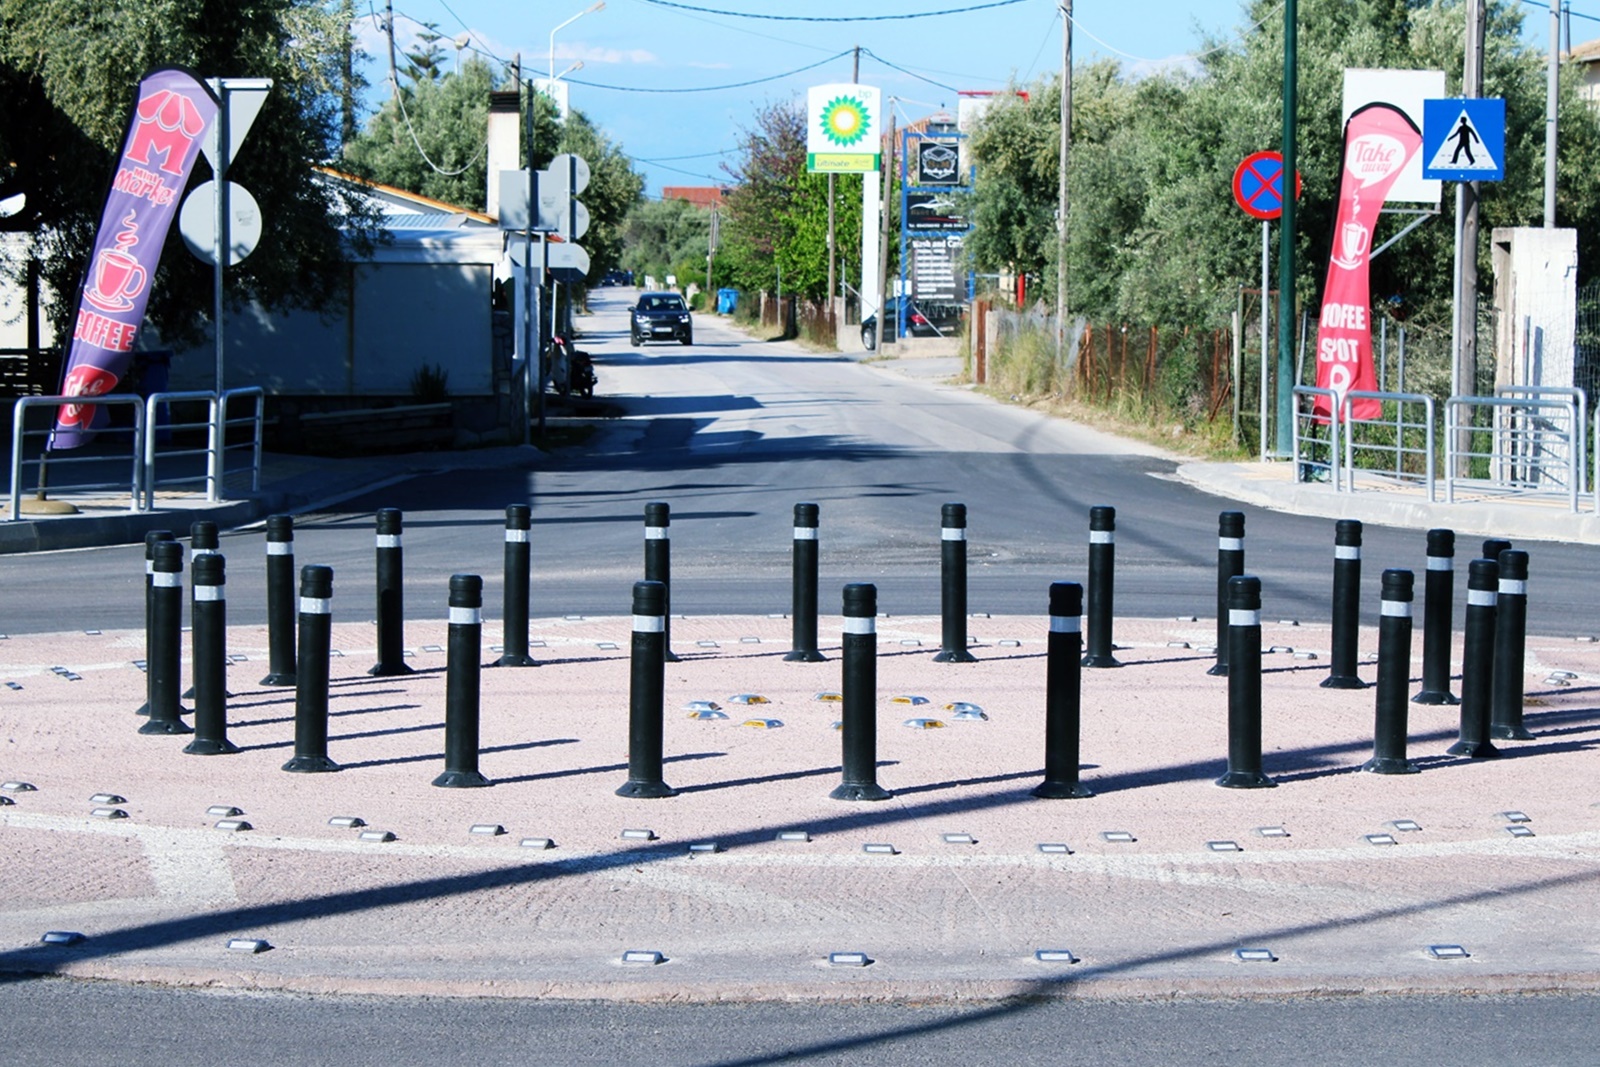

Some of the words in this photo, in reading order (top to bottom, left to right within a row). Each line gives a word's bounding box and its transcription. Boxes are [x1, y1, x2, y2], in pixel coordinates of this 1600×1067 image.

[858, 89, 872, 100] bp
[1354, 140, 1397, 163] Take
[1361, 162, 1392, 176] away
